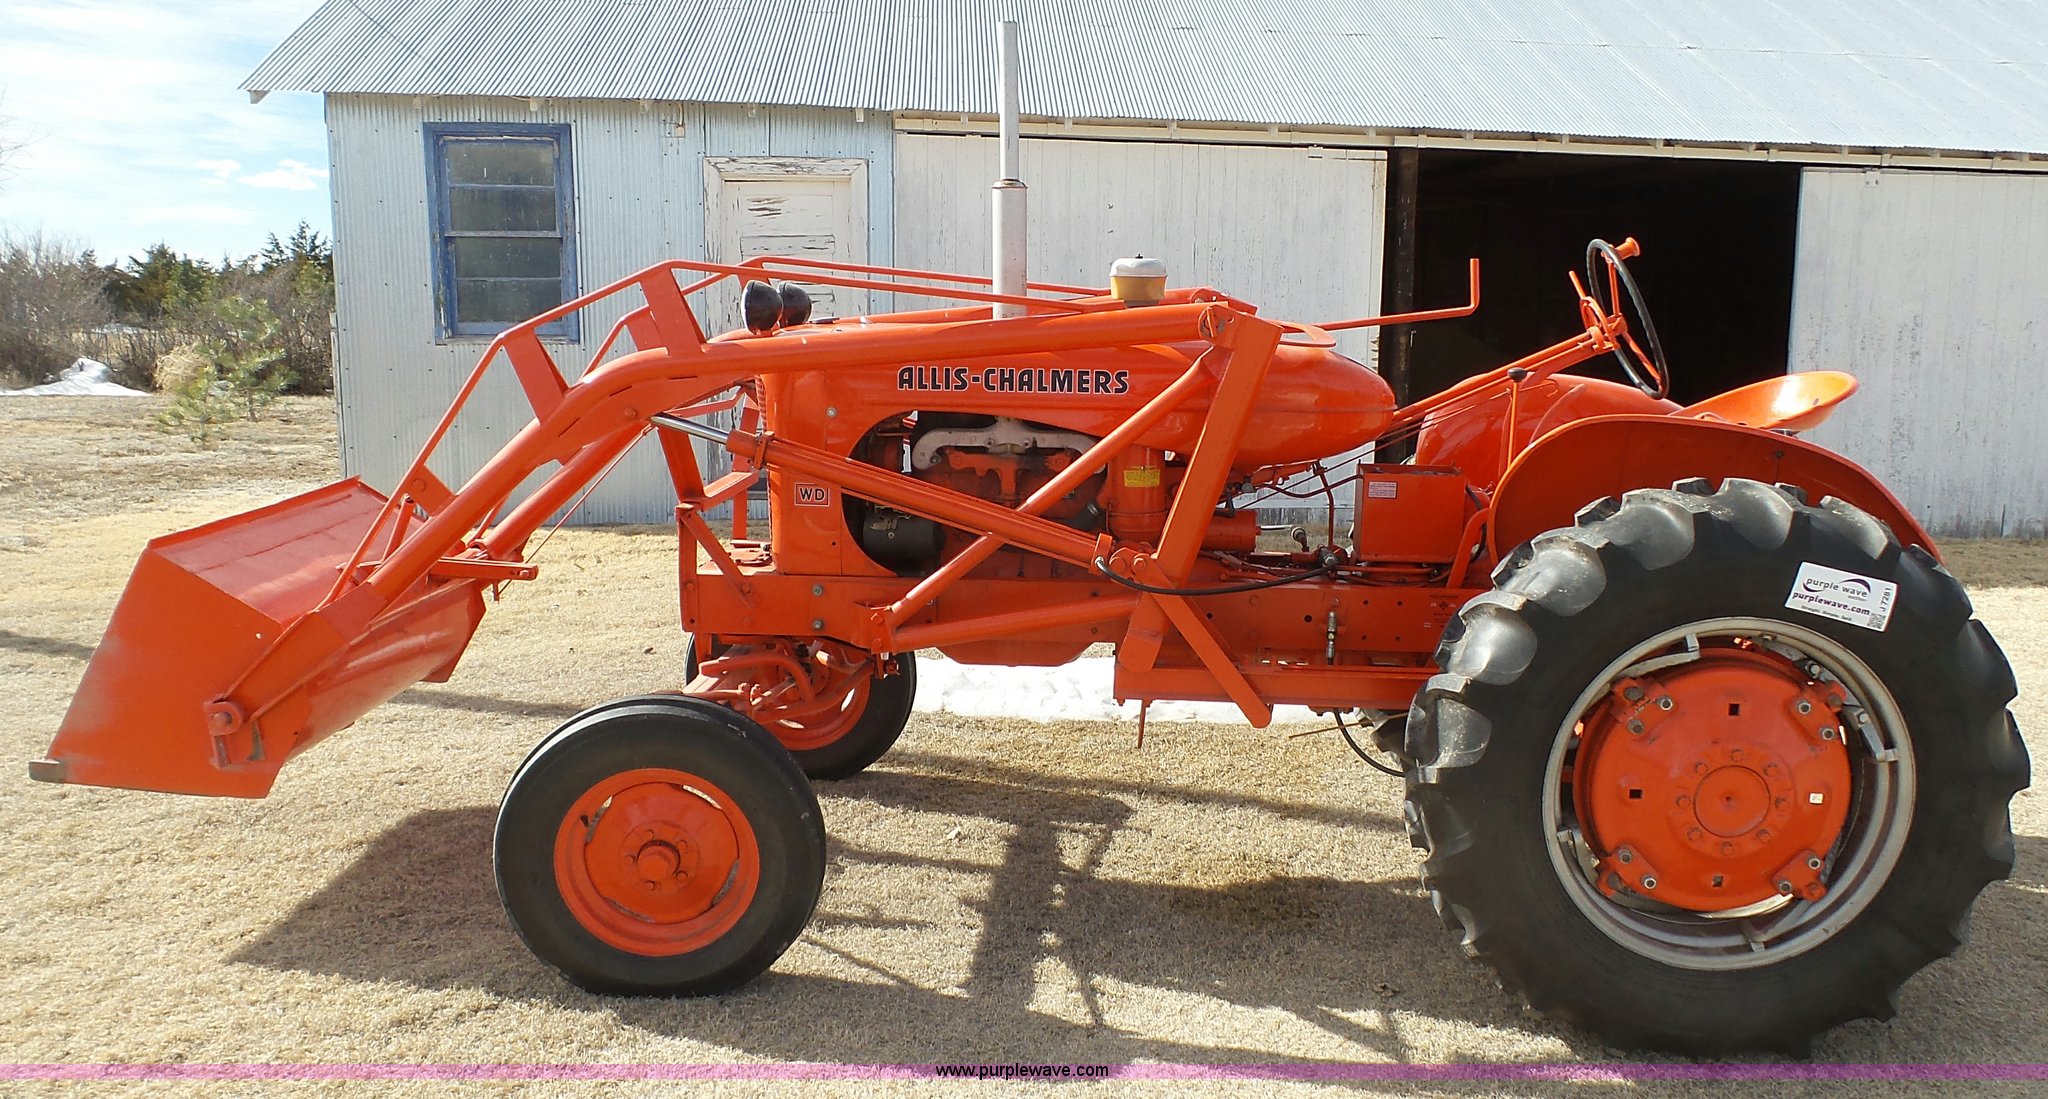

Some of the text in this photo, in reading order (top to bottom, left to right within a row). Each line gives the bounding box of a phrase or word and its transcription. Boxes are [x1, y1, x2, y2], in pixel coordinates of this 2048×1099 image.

[898, 366, 1129, 394] ALLIS-CHALMERS
[799, 487, 825, 501] WD
[1806, 578, 1868, 598] purple wave
[1792, 592, 1870, 616] purplewave.com
